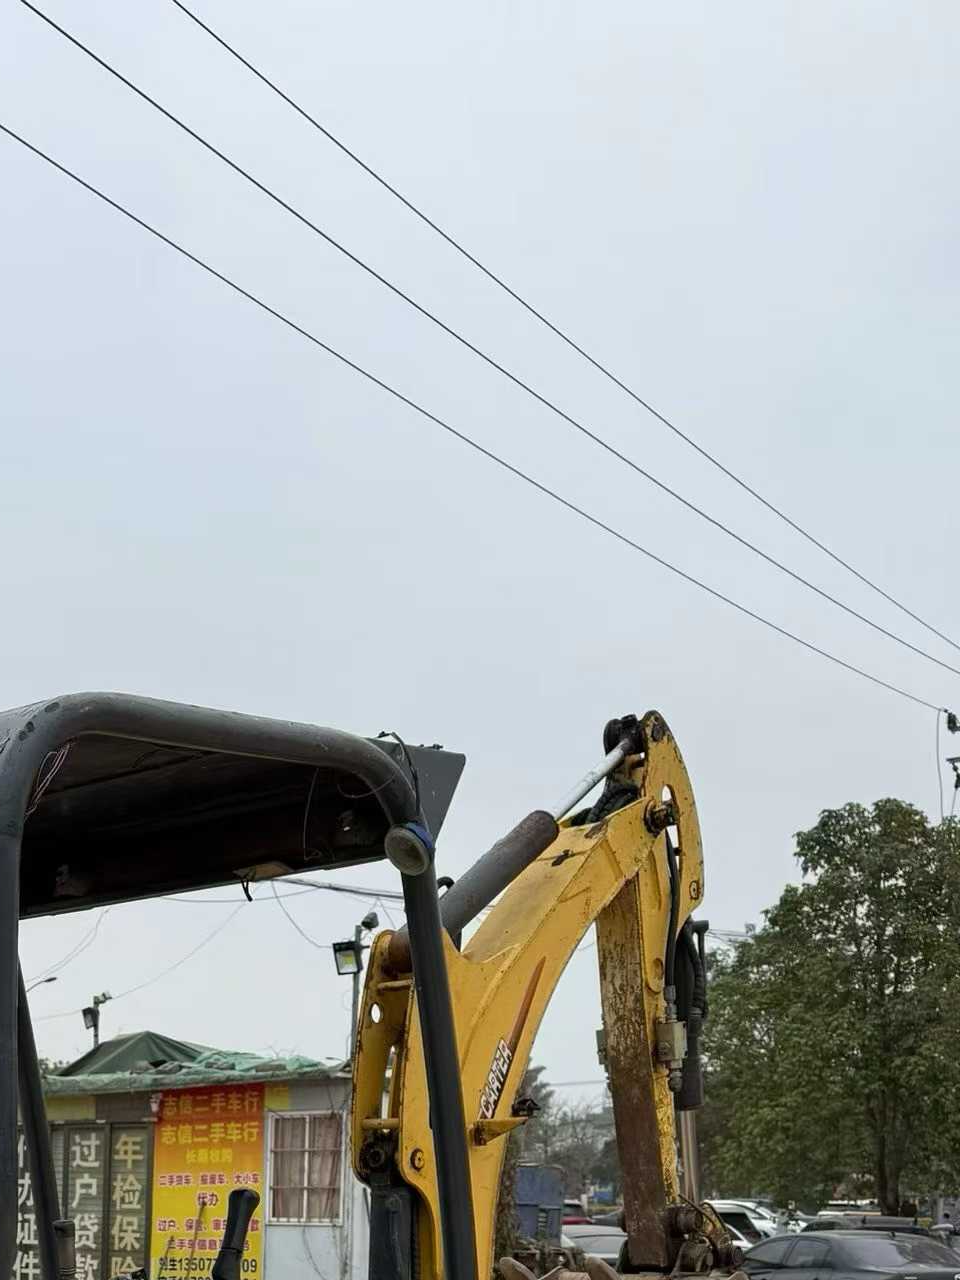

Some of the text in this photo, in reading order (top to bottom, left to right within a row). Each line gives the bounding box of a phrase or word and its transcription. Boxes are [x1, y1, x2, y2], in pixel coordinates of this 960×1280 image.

[162, 1091, 260, 1117] 志信二手车行
[160, 1121, 259, 1145] 志信二手车行
